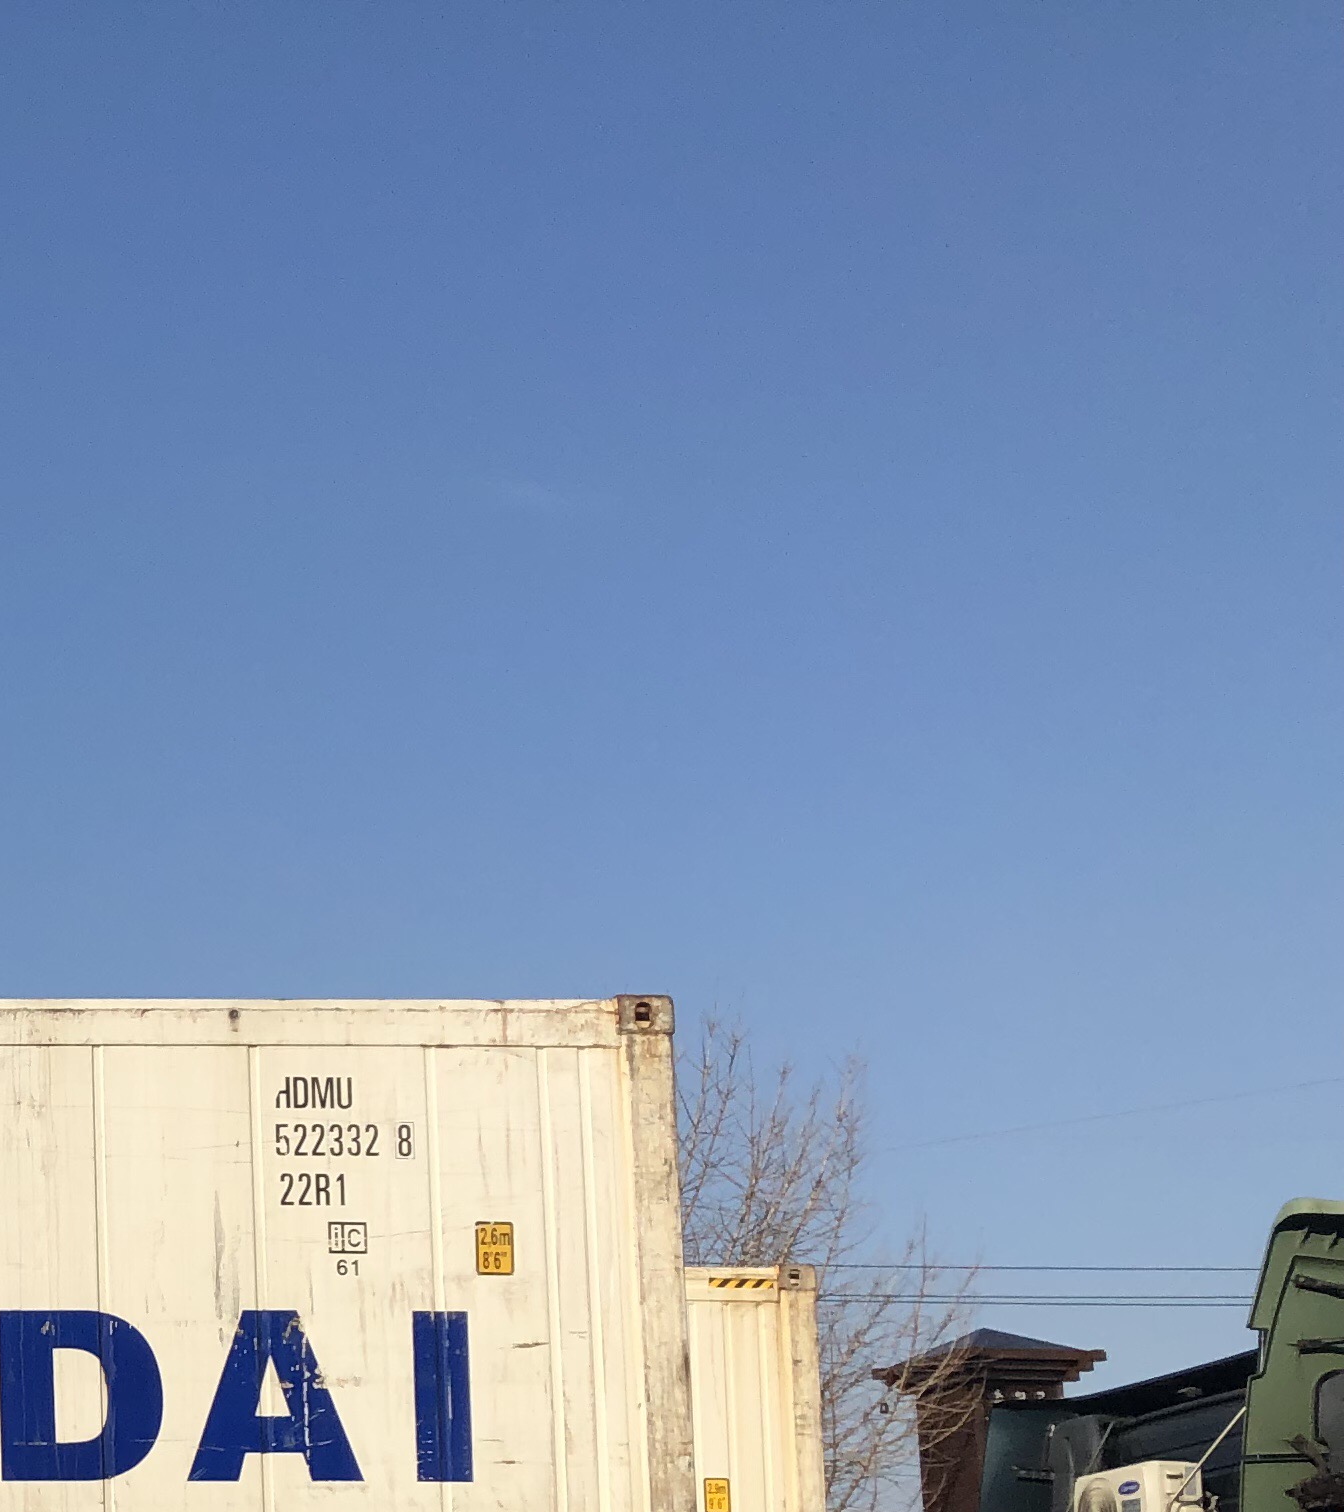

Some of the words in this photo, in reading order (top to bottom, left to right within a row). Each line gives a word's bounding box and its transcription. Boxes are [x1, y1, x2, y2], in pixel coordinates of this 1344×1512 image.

[275, 1076, 353, 1109] HDMU
[275, 1123, 380, 1157] 522332
[397, 1123, 412, 1157] 8
[280, 1172, 346, 1206] 22R1
[336, 1259, 359, 1276] 61
